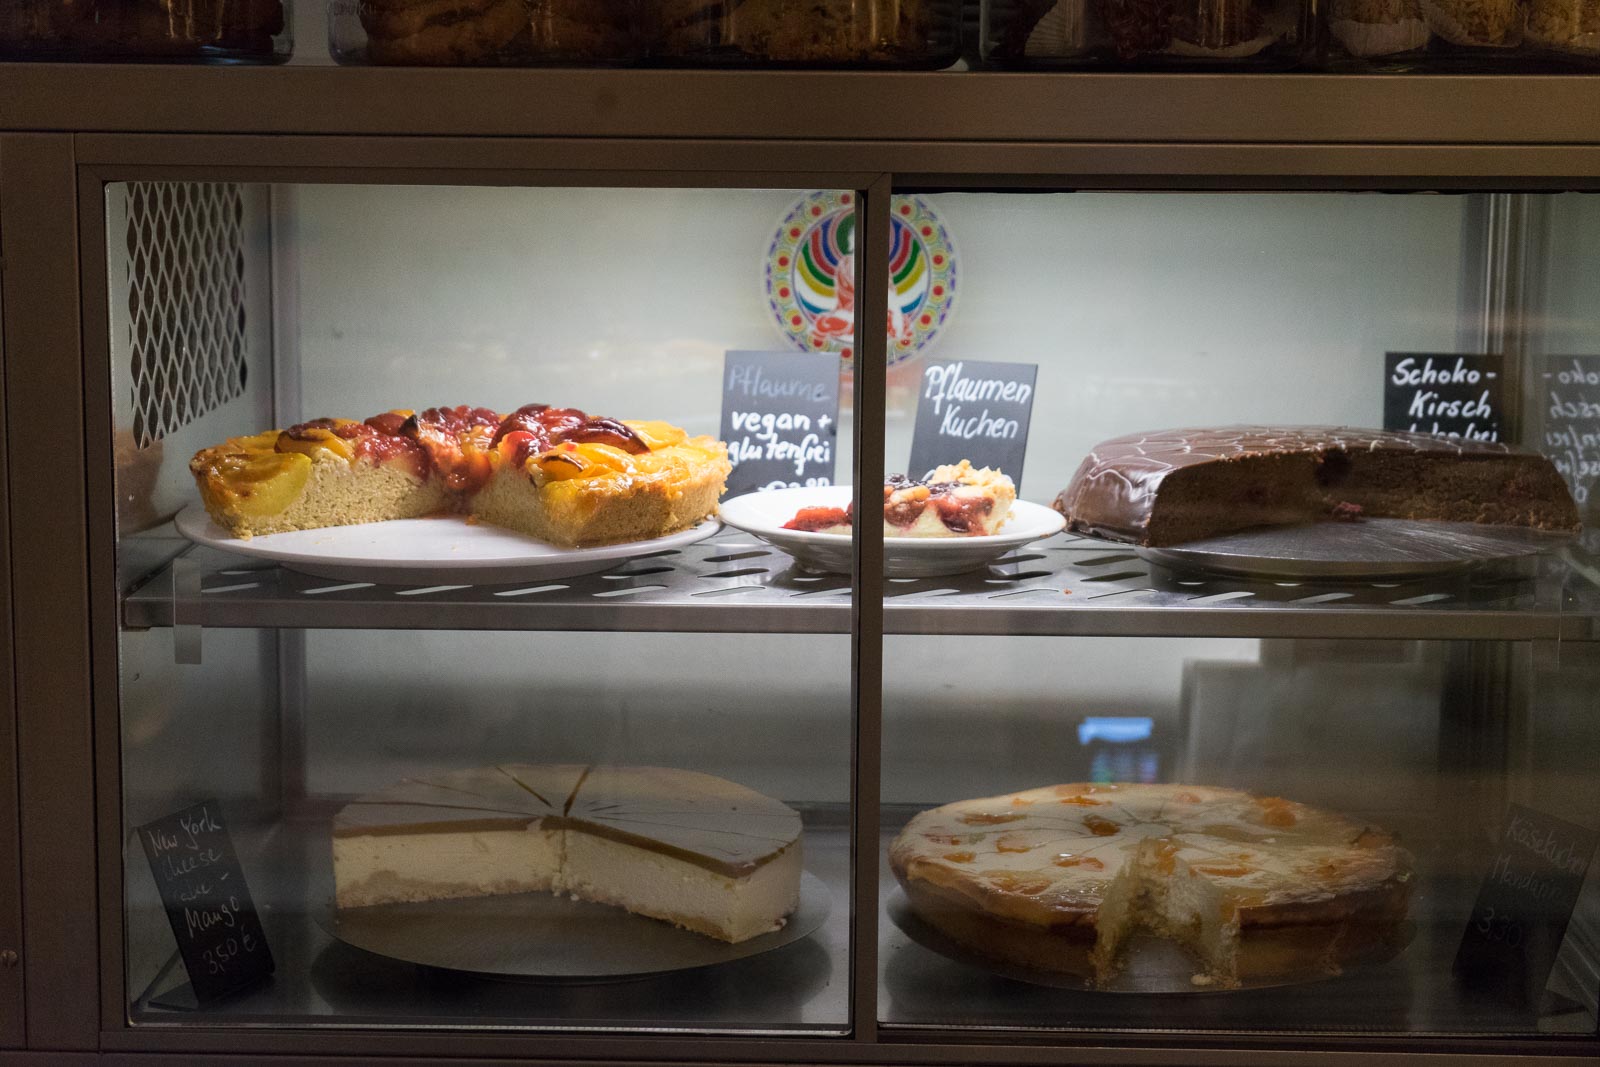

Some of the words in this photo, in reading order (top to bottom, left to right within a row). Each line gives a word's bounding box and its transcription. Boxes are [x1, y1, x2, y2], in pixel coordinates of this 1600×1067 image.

[728, 364, 831, 402] Pflaume
[925, 361, 1032, 415] Pflaumen
[940, 403, 1019, 439] Kuchen
[1408, 390, 1492, 418] Kirsch
[732, 411, 811, 440] vegan
[818, 414, 832, 428] +
[148, 829, 178, 857] New
[180, 806, 223, 851] York
[185, 895, 240, 939] Mango
